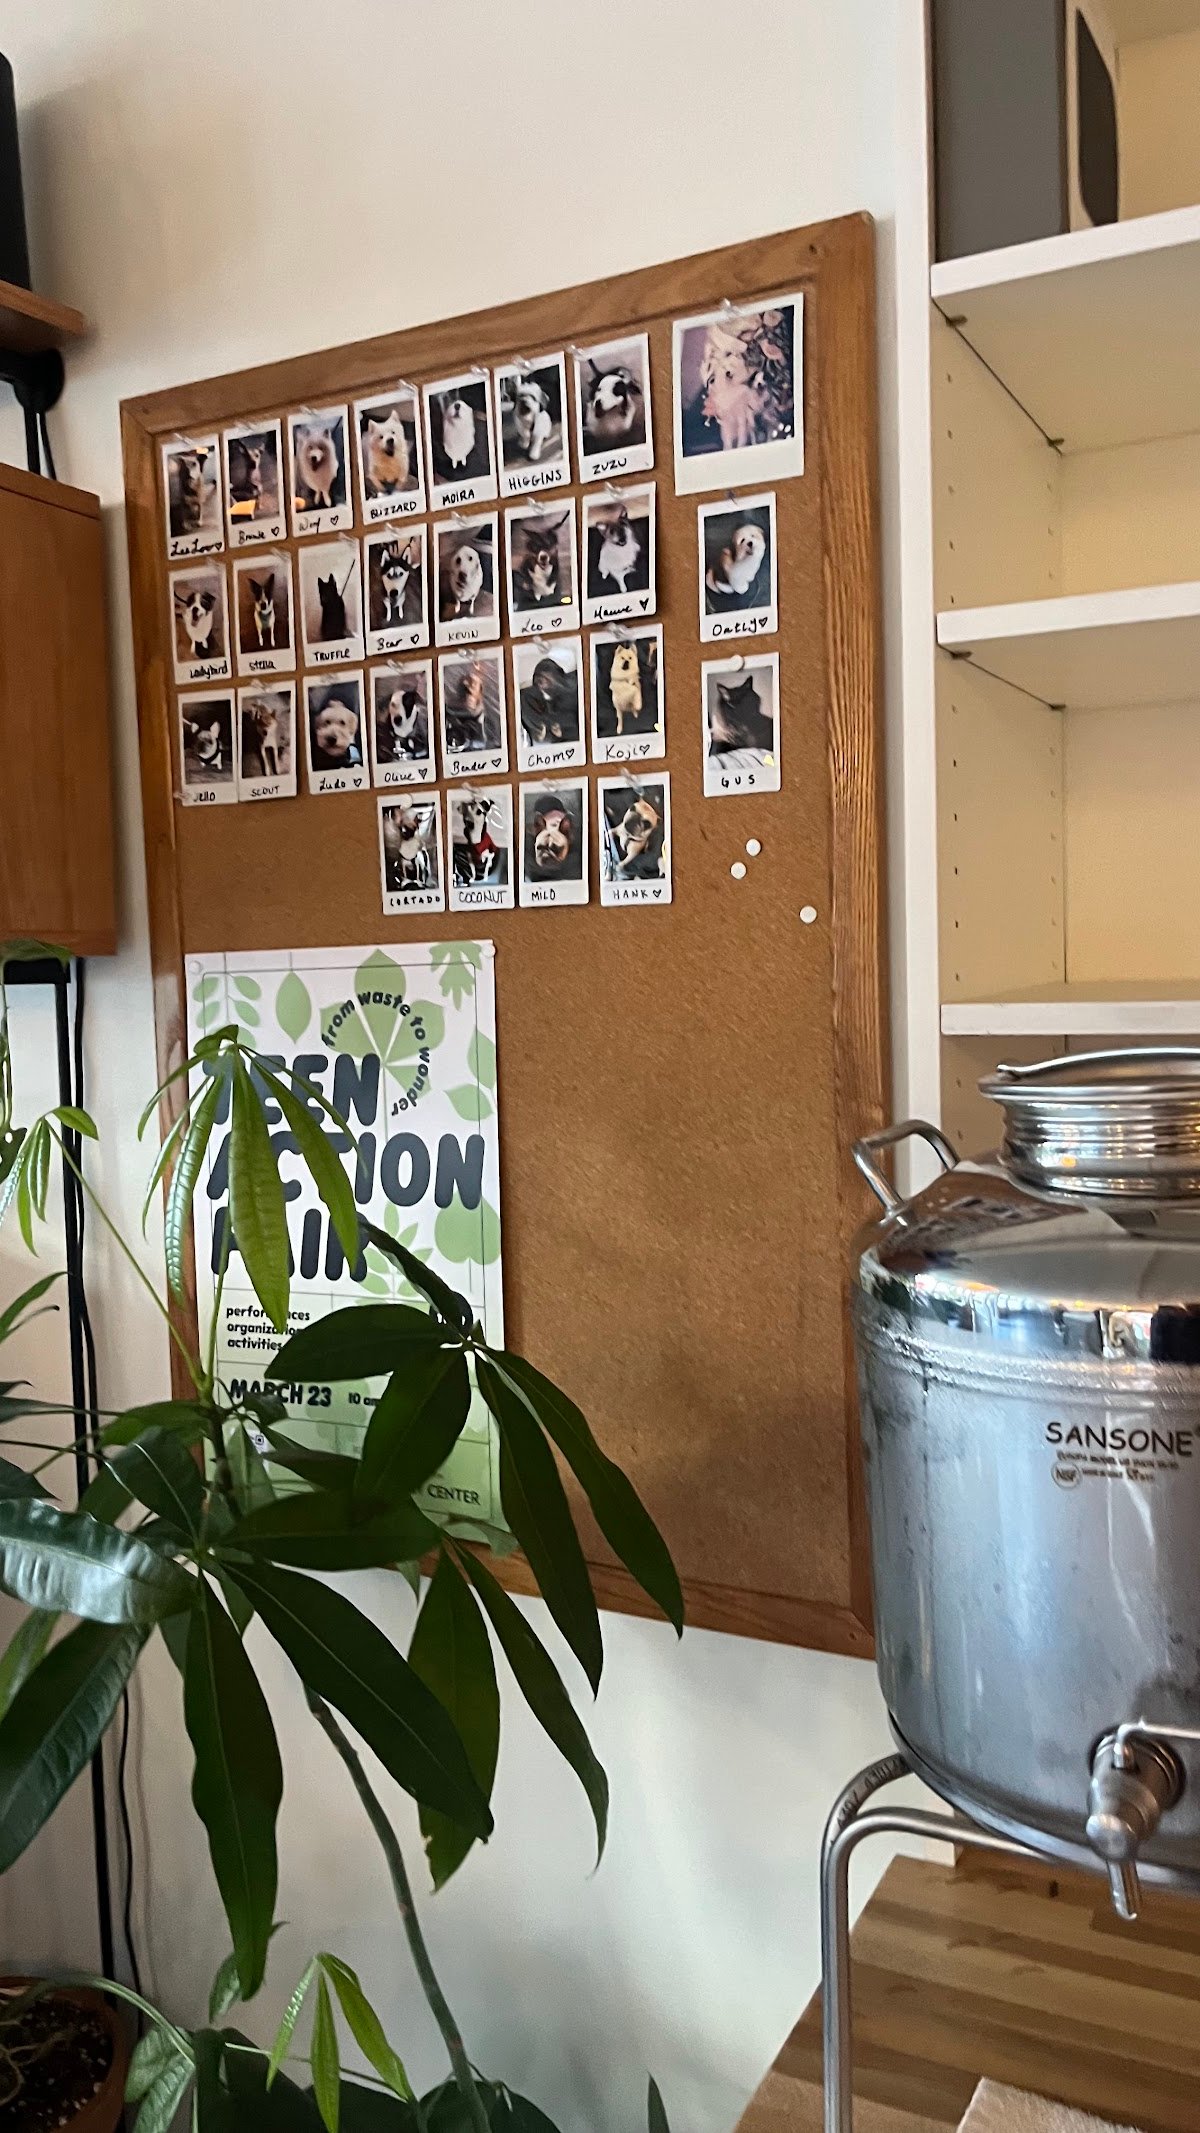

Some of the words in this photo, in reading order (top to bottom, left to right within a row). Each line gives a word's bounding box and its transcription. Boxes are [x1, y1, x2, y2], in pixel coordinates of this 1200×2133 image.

[592, 457, 627, 475] ZUZU
[508, 469, 562, 491] HIGGINS
[442, 488, 475, 506] MOIRA
[521, 617, 543, 633] Leo
[712, 617, 757, 637] Oatly
[448, 630, 479, 642] KEVIN
[314, 648, 350, 661] TRUFFLE
[605, 743, 638, 760] Koji
[389, 895, 441, 907] CORTADO
[458, 890, 507, 904] COCONUT
[613, 889, 648, 900] HANK
[358, 991, 411, 1017] waste
[321, 999, 356, 1047] from
[410, 1016, 426, 1041] to
[391, 1046, 430, 1116] wonder
[206, 1130, 486, 1211] CION
[308, 1385, 331, 1407] 23
[348, 1392, 361, 1405] 10
[1045, 1422, 1193, 1456] SANSONE
[427, 1484, 481, 1505] CENTER
